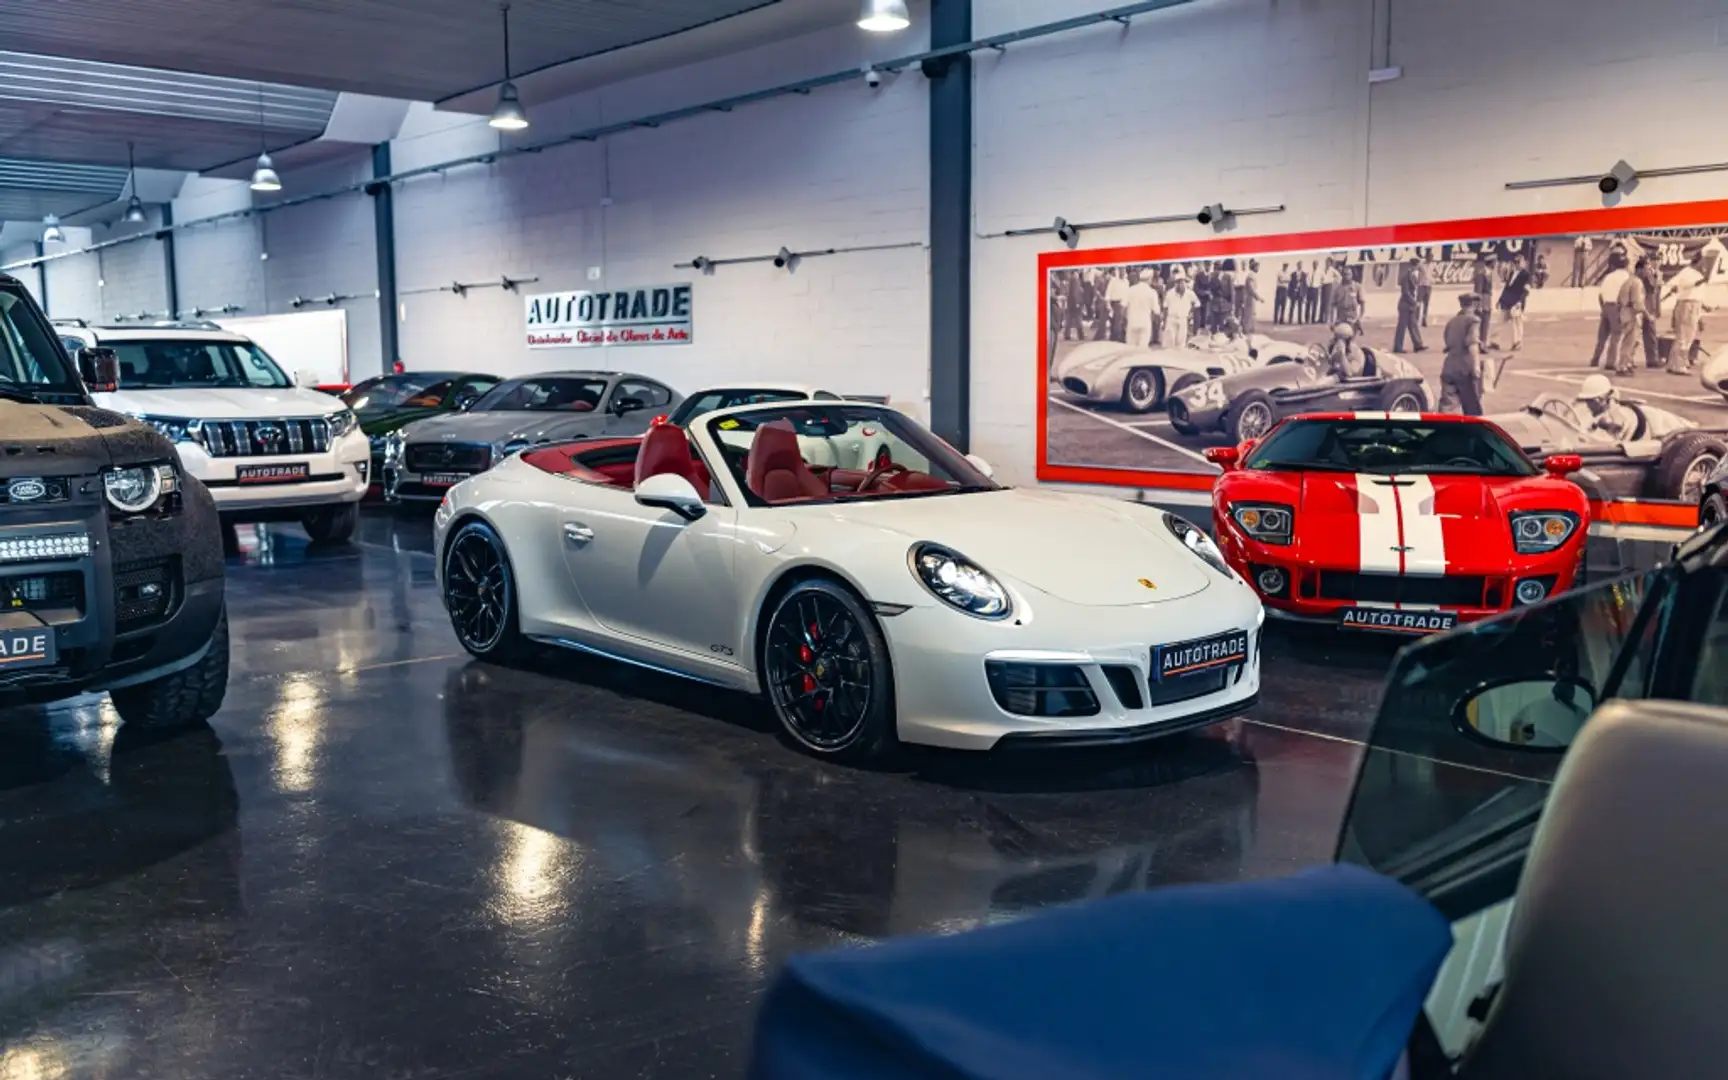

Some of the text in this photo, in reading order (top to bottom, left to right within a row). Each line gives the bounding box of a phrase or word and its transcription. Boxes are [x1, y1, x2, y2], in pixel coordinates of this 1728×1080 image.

[528, 286, 691, 325] AUTOTRADE
[1188, 380, 1226, 409] 34
[241, 466, 306, 478] AUTOTRADE
[1343, 605, 1453, 629] AUTOTRADE
[1163, 636, 1245, 669] AUTOTRADE
